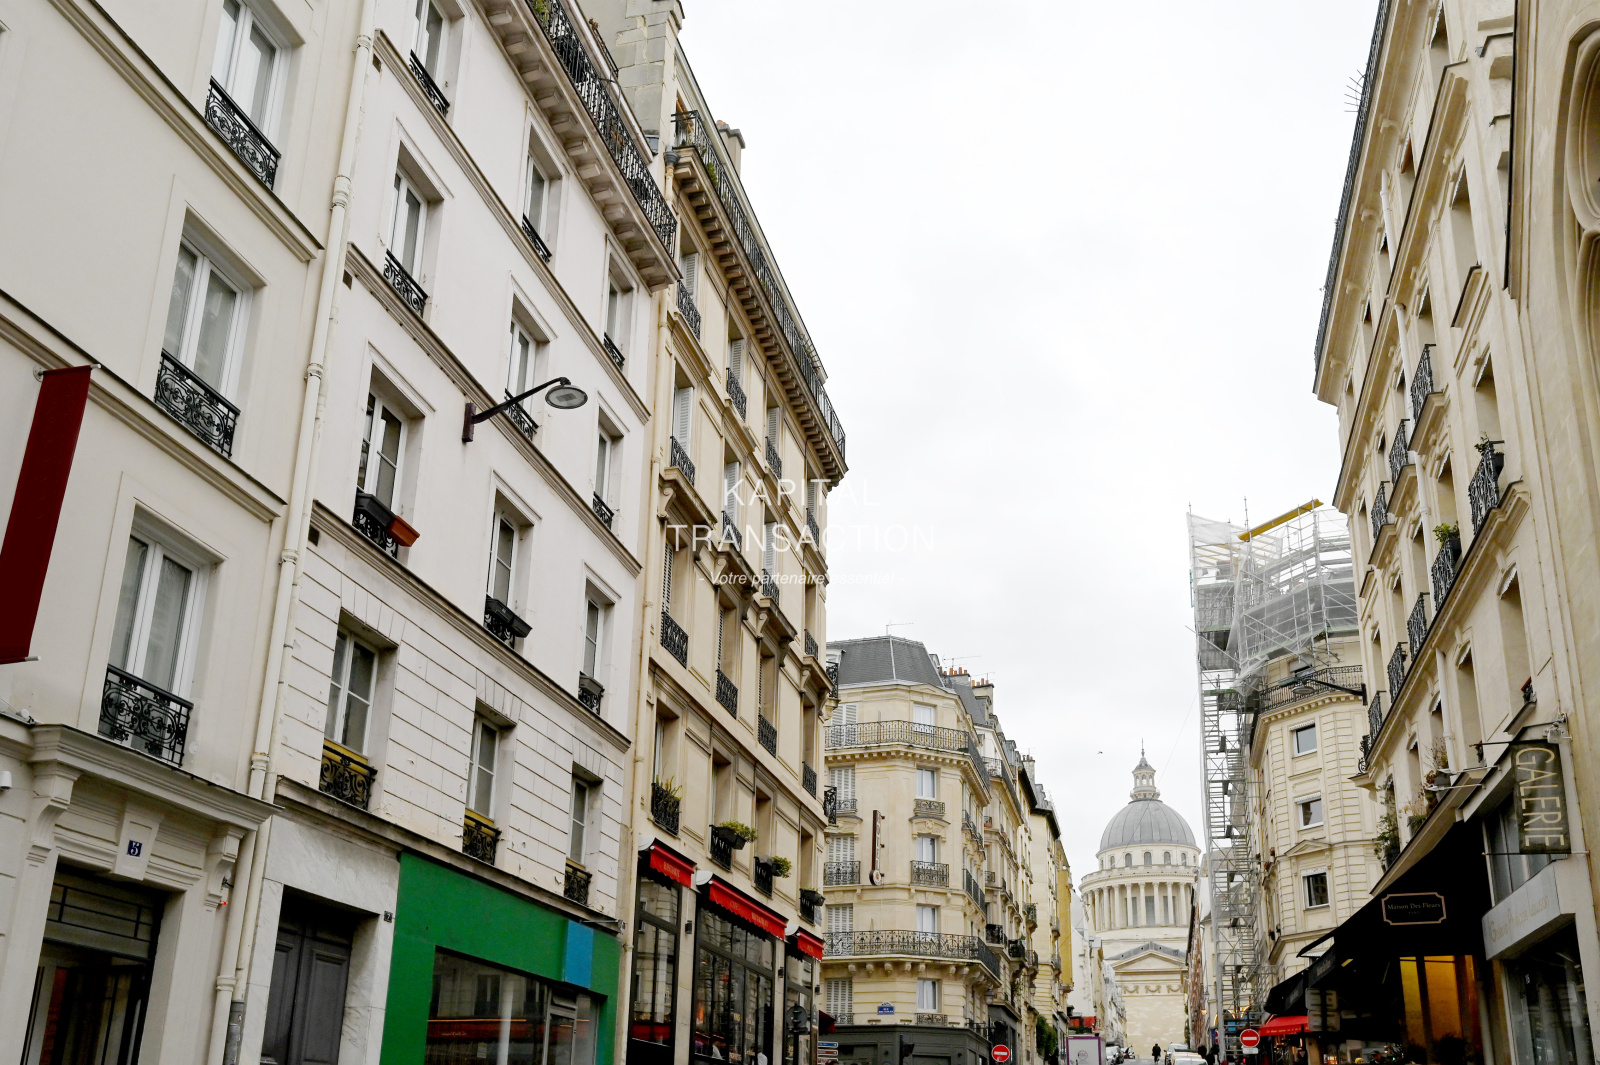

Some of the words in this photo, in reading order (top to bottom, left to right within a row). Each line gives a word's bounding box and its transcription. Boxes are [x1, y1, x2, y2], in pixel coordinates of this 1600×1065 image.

[1515, 747, 1565, 847] GALERIE
[130, 841, 140, 856] 5
[1387, 903, 1409, 911] Maison
[1410, 902, 1422, 910] Des
[1422, 901, 1441, 909] Fleurs
